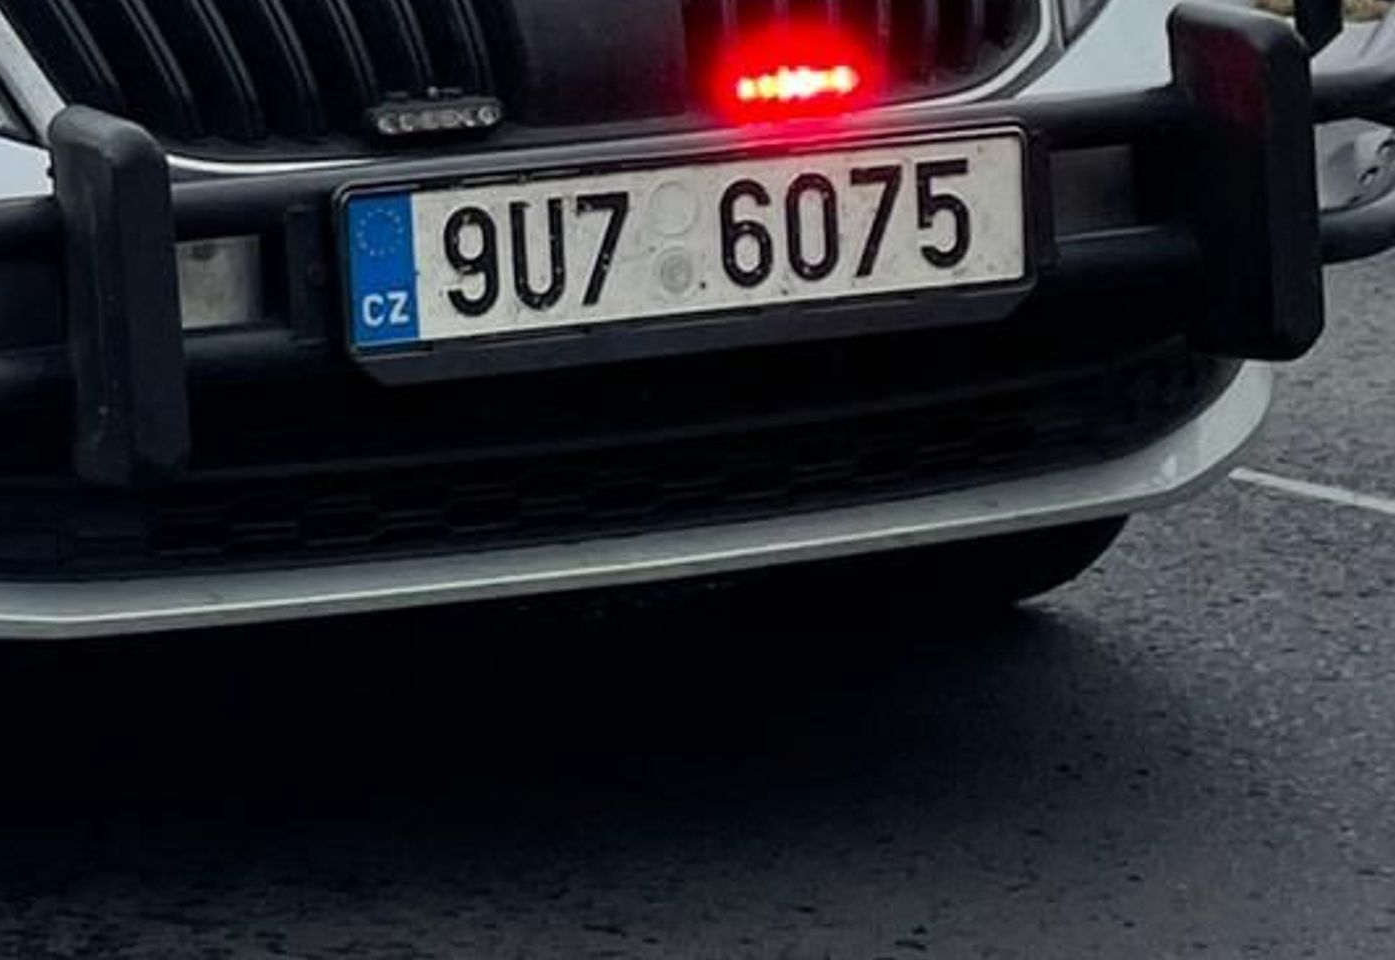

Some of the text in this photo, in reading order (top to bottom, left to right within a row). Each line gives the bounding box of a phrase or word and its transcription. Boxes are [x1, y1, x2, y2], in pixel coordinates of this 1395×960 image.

[442, 158, 971, 317] 9U7 6075
[361, 295, 408, 328] CZ
